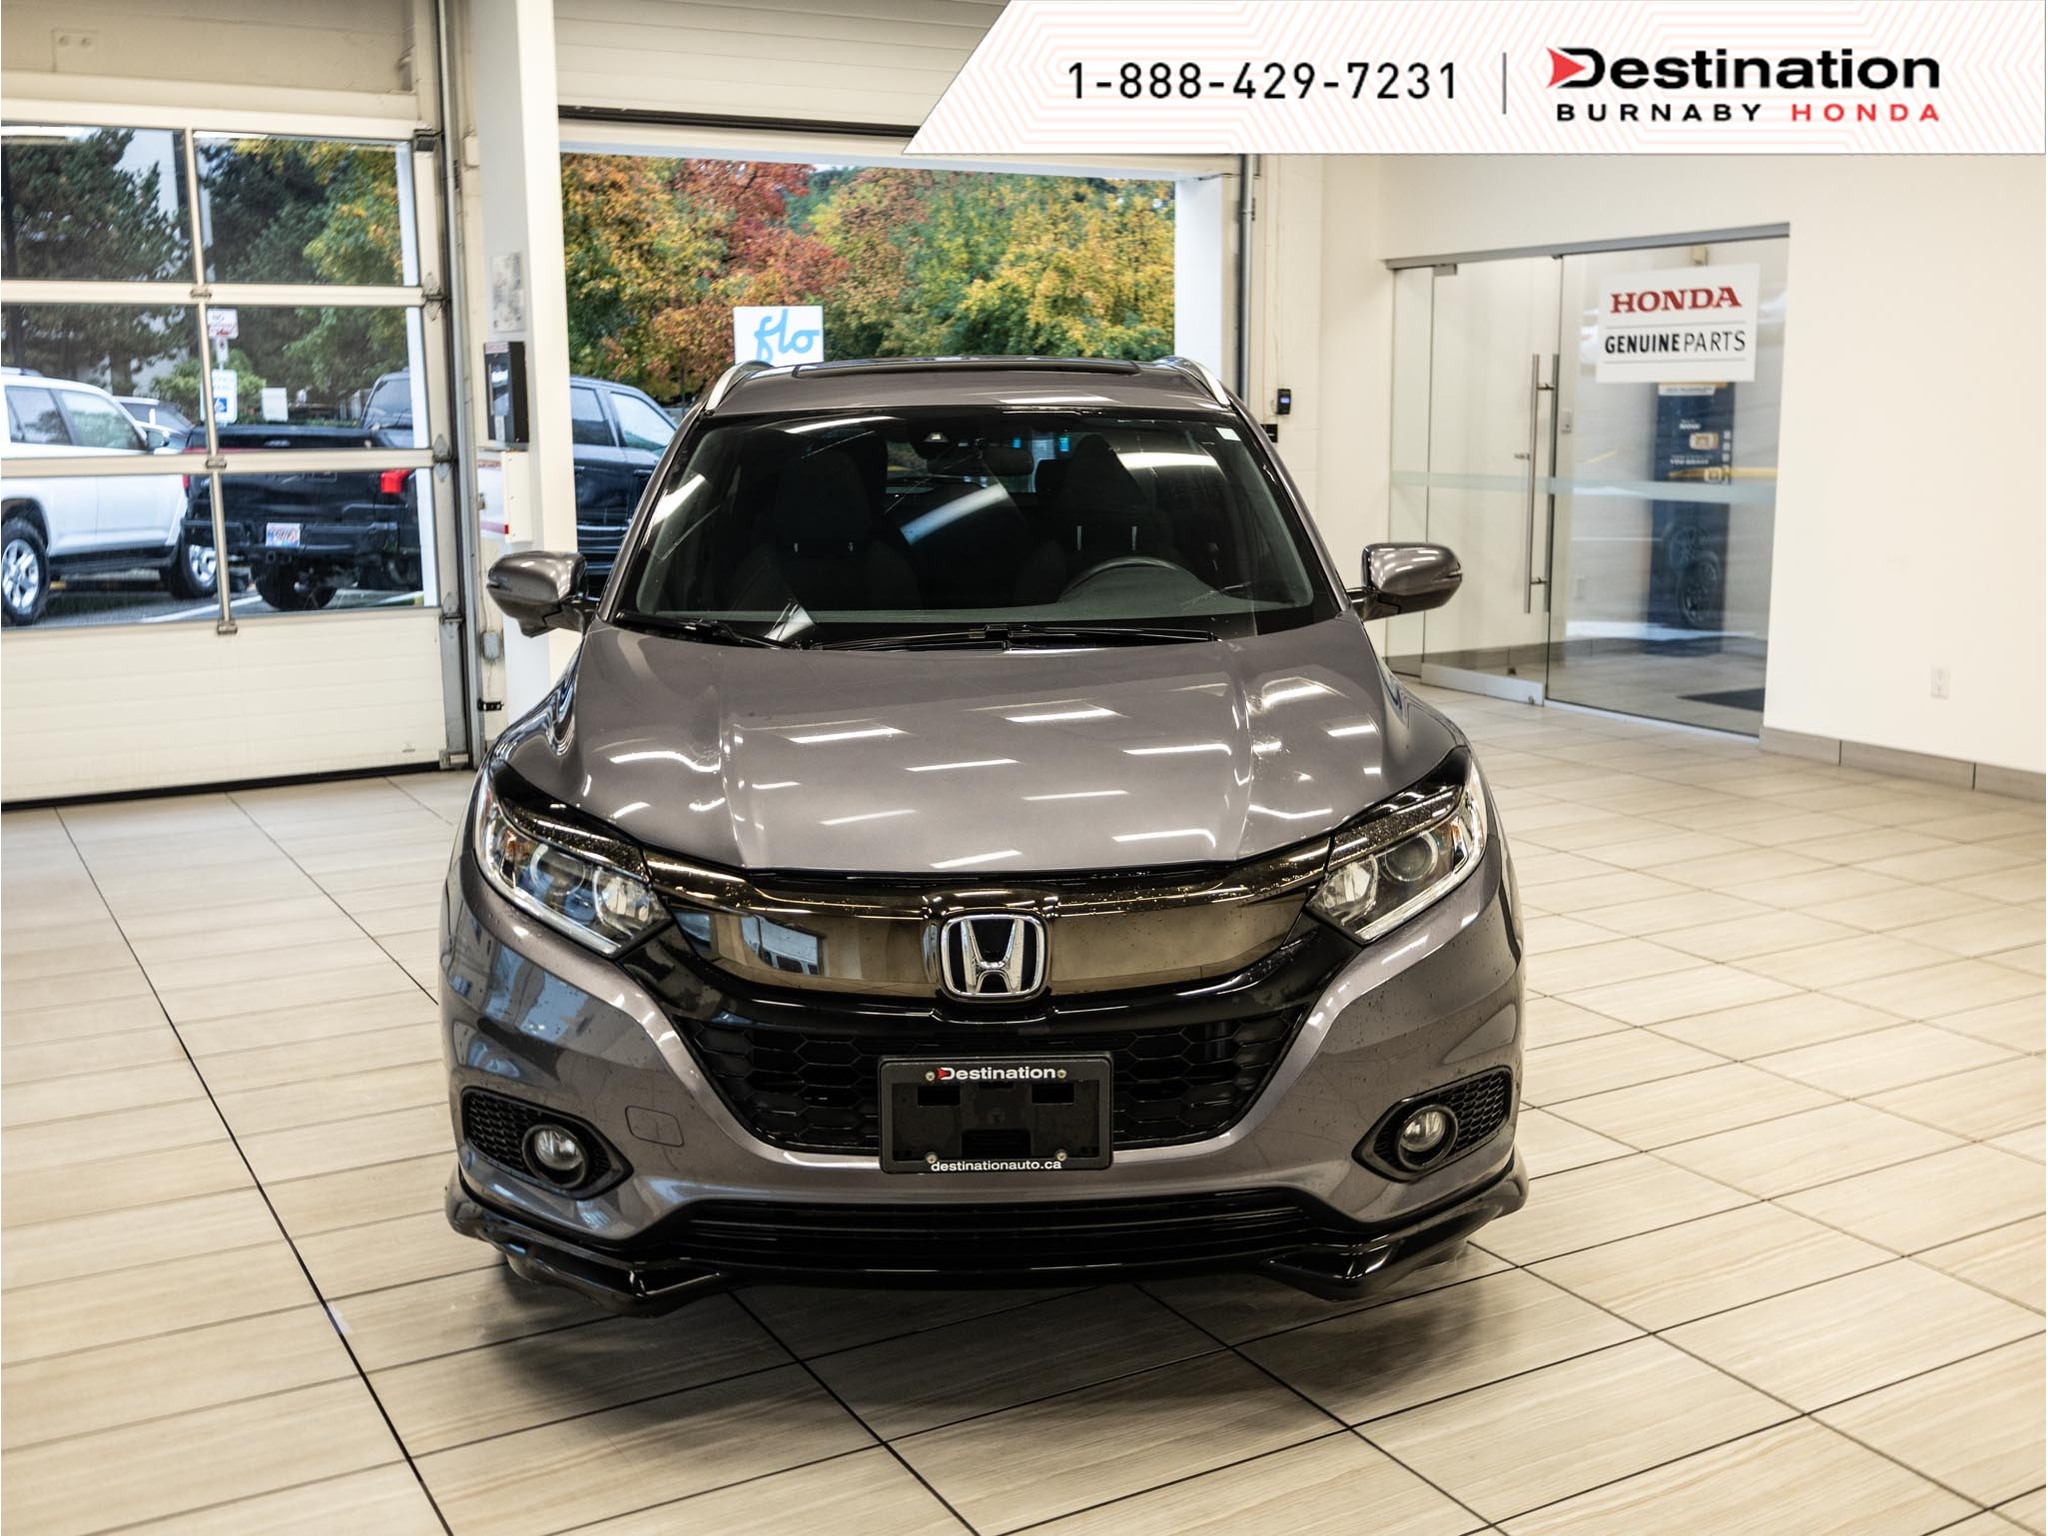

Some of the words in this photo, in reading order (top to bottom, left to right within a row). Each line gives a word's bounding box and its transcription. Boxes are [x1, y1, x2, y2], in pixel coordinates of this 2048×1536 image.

[1610, 286, 1742, 314] HONDA
[936, 1066, 1056, 1081] Destination
[930, 1159, 1062, 1172] destinationauto.ca
